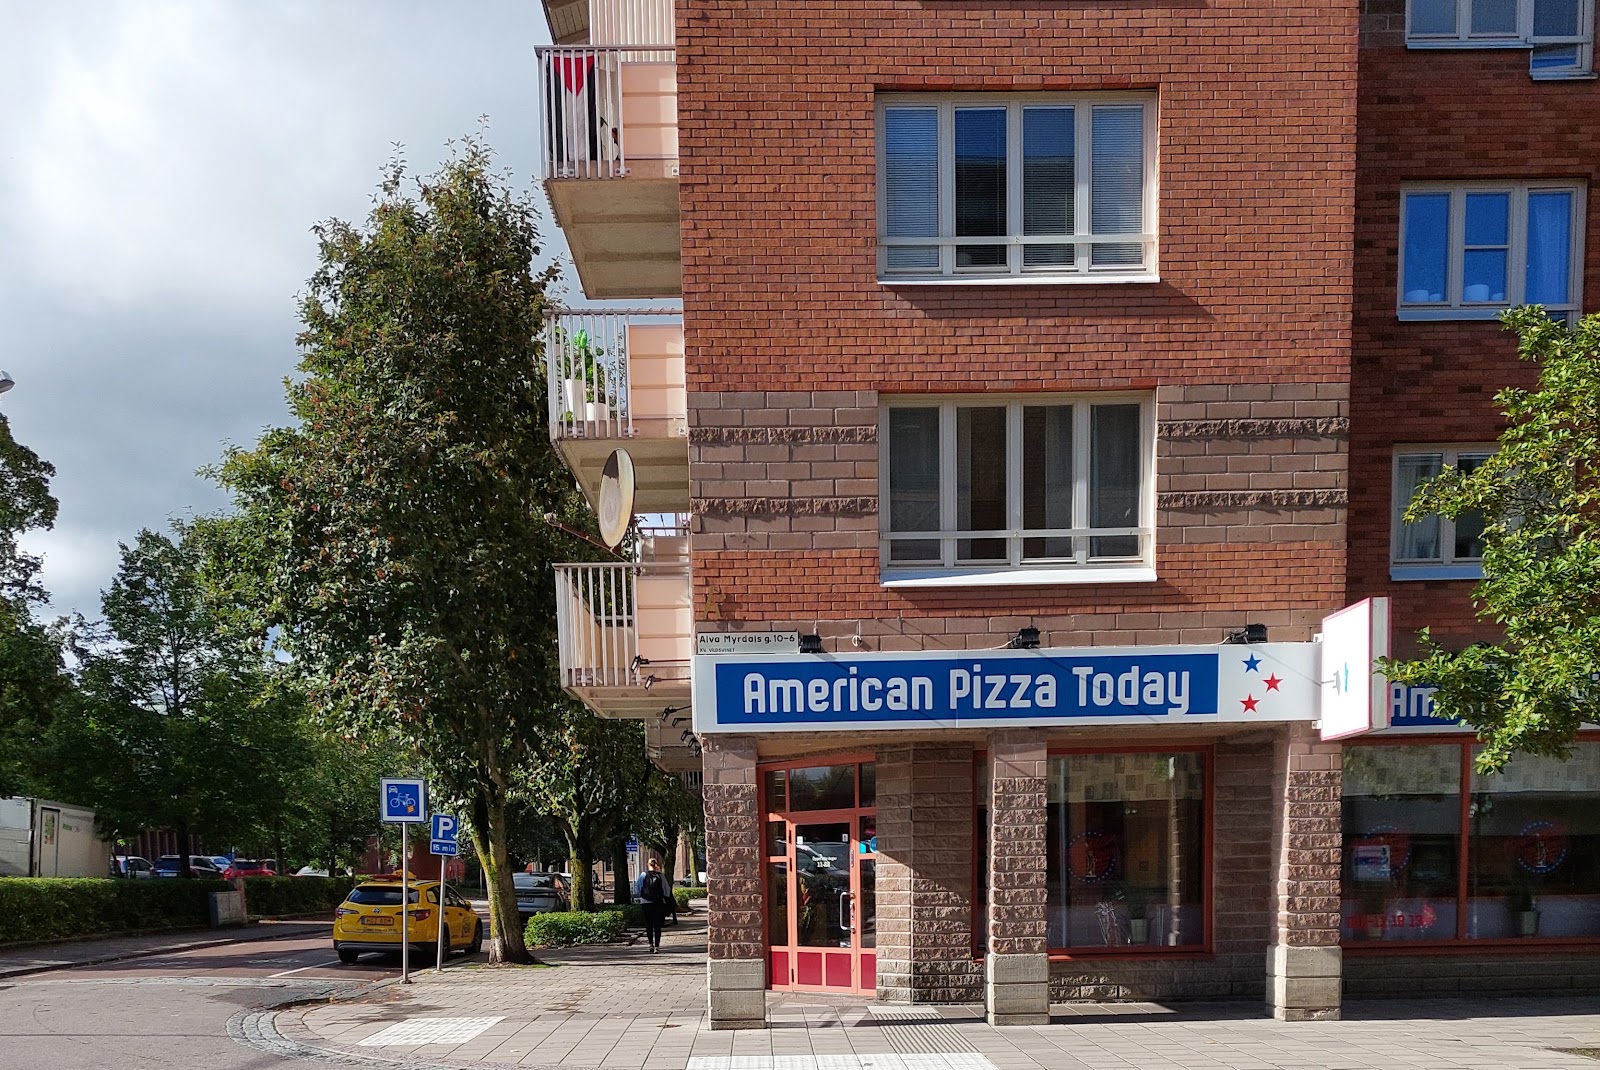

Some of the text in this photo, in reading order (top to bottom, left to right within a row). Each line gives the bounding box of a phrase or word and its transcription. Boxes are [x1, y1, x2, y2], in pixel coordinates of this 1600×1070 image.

[699, 634, 795, 645] Alva Myrdals g. 10-6
[743, 663, 1191, 716] American Pizza Today
[439, 817, 454, 838] P
